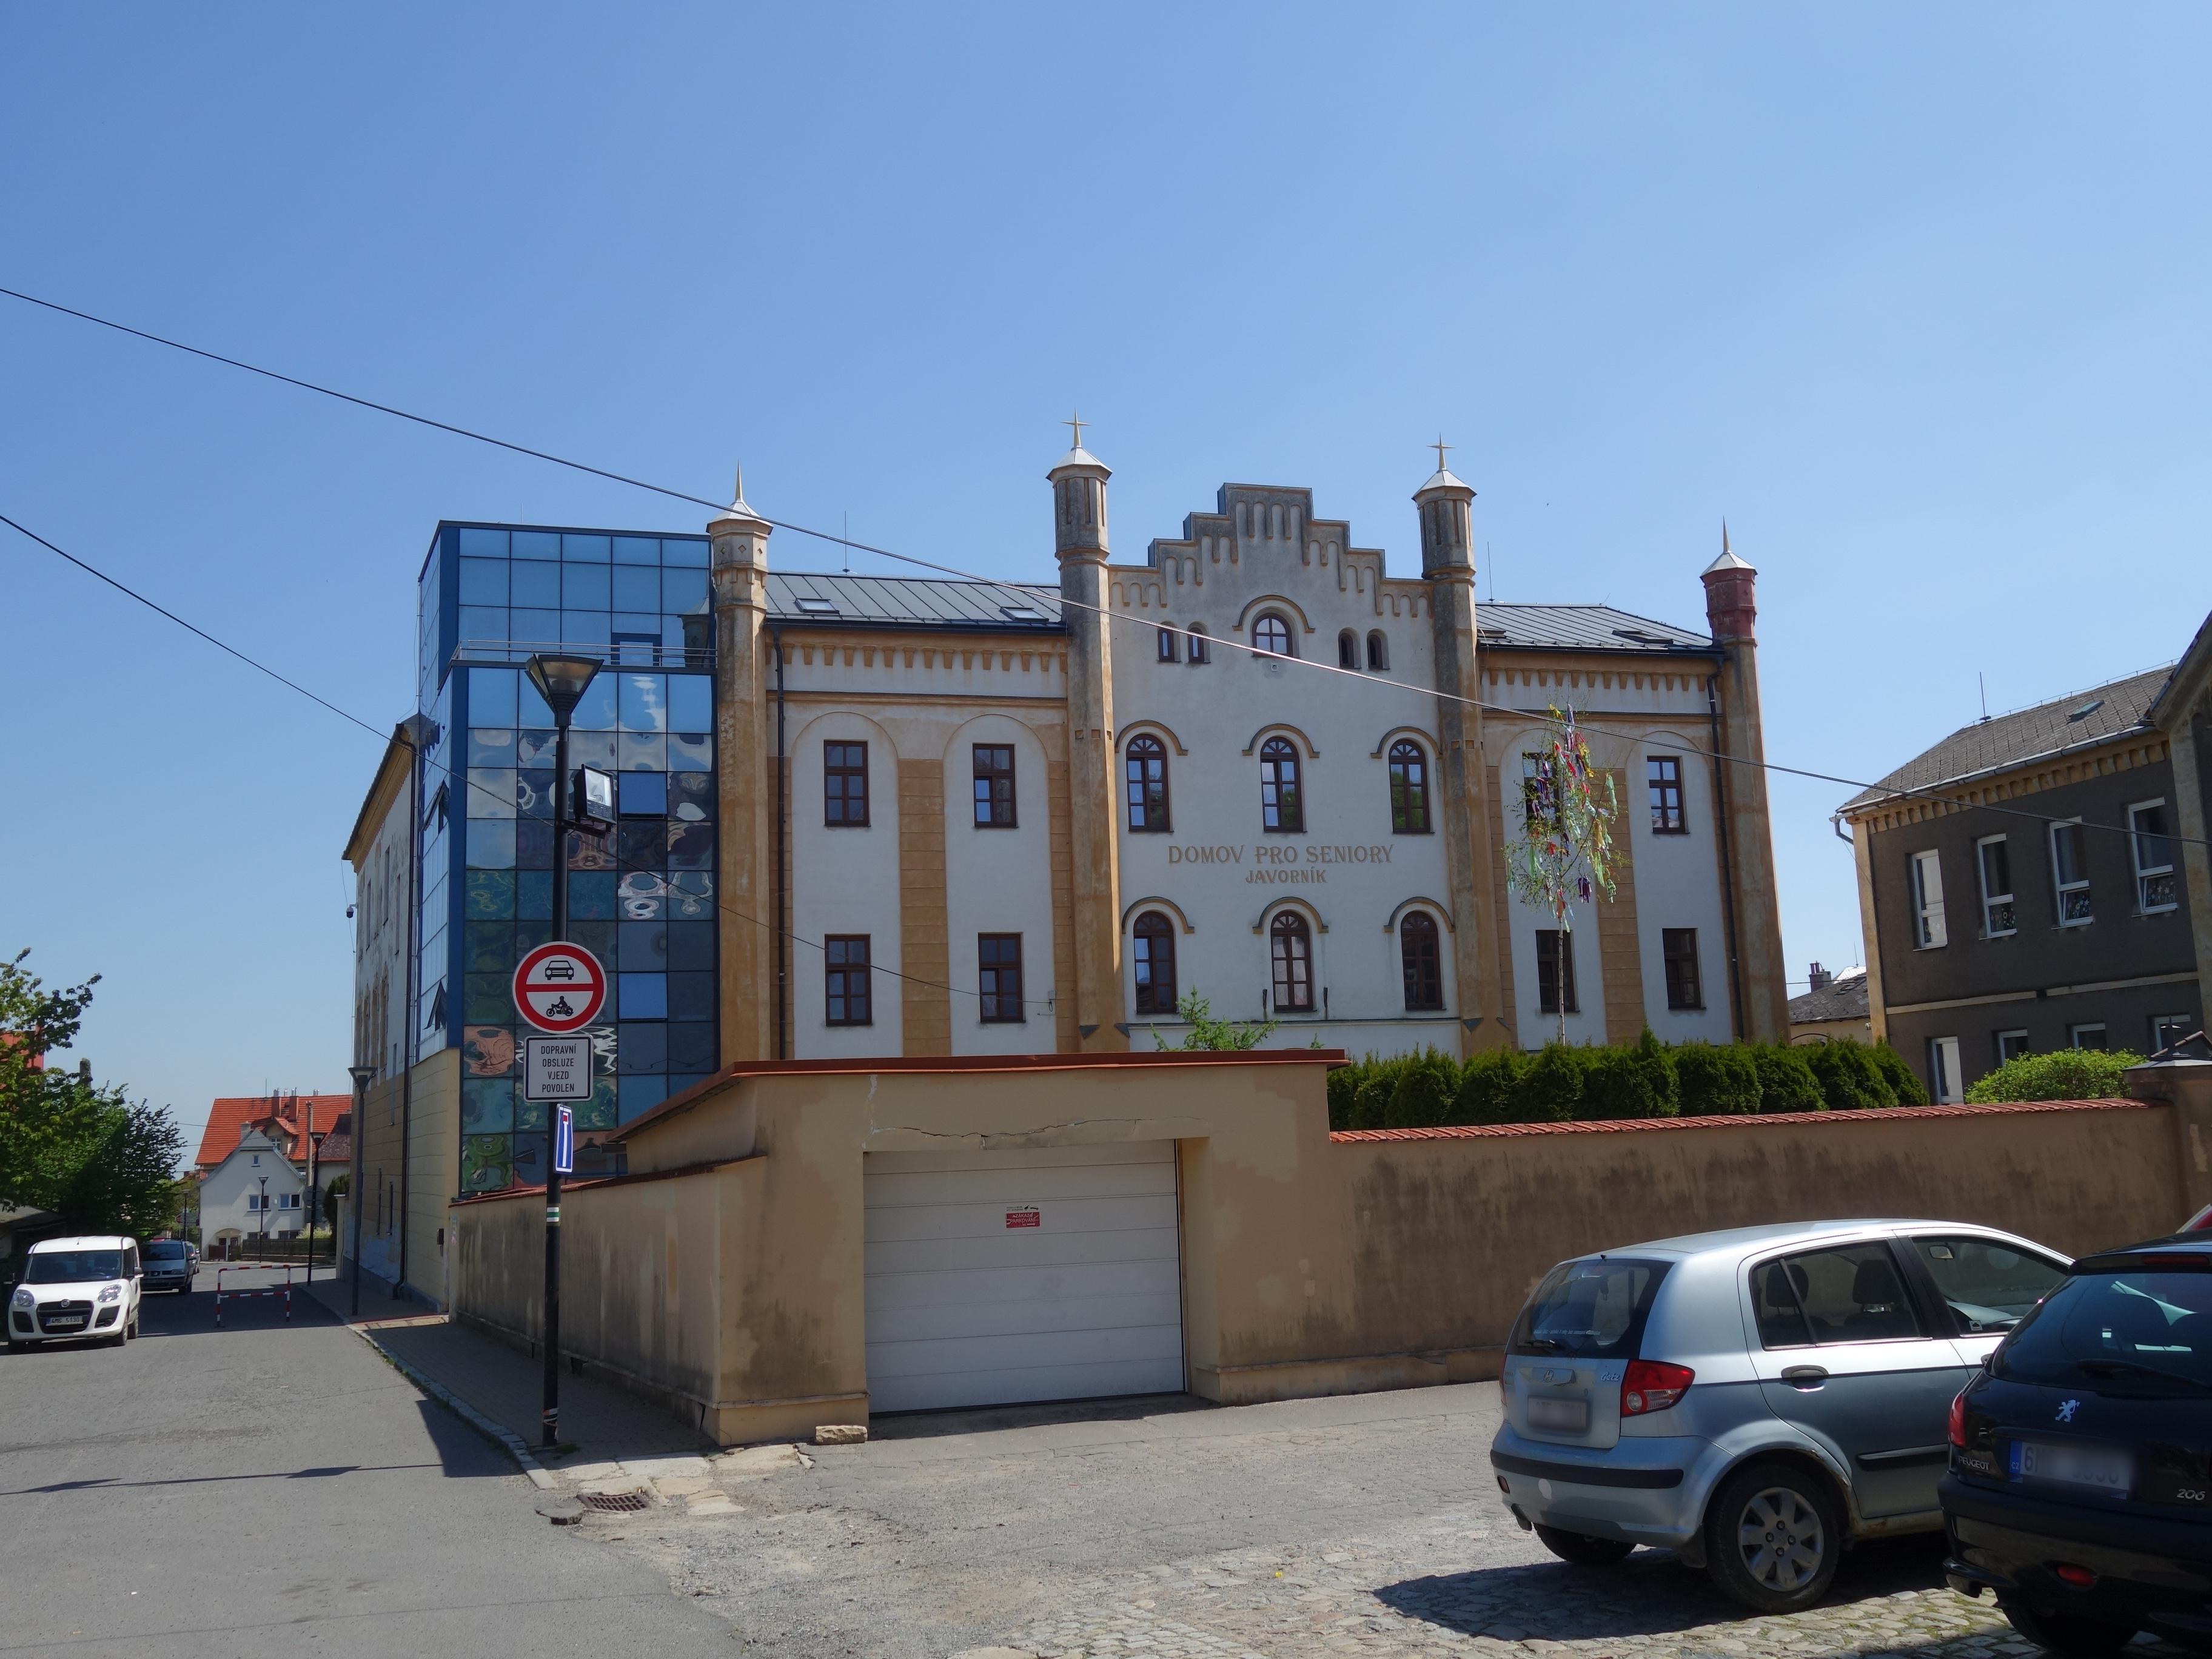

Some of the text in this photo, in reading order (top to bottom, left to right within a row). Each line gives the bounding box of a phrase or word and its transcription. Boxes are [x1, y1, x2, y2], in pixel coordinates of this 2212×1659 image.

[1168, 844, 1394, 865] DOMOV PRO SENIORY
[1245, 866, 1329, 884] JAVORNÍK
[541, 1044, 577, 1054] DOPRAVNÍ
[542, 1058, 574, 1067] OBSLUZE
[548, 1071, 569, 1080] VJEZD
[542, 1084, 574, 1093] POVOLEN
[1601, 1372, 1620, 1382] Getz
[1959, 1456, 1989, 1470] PEUGEOT
[2177, 1488, 2206, 1501] 206
